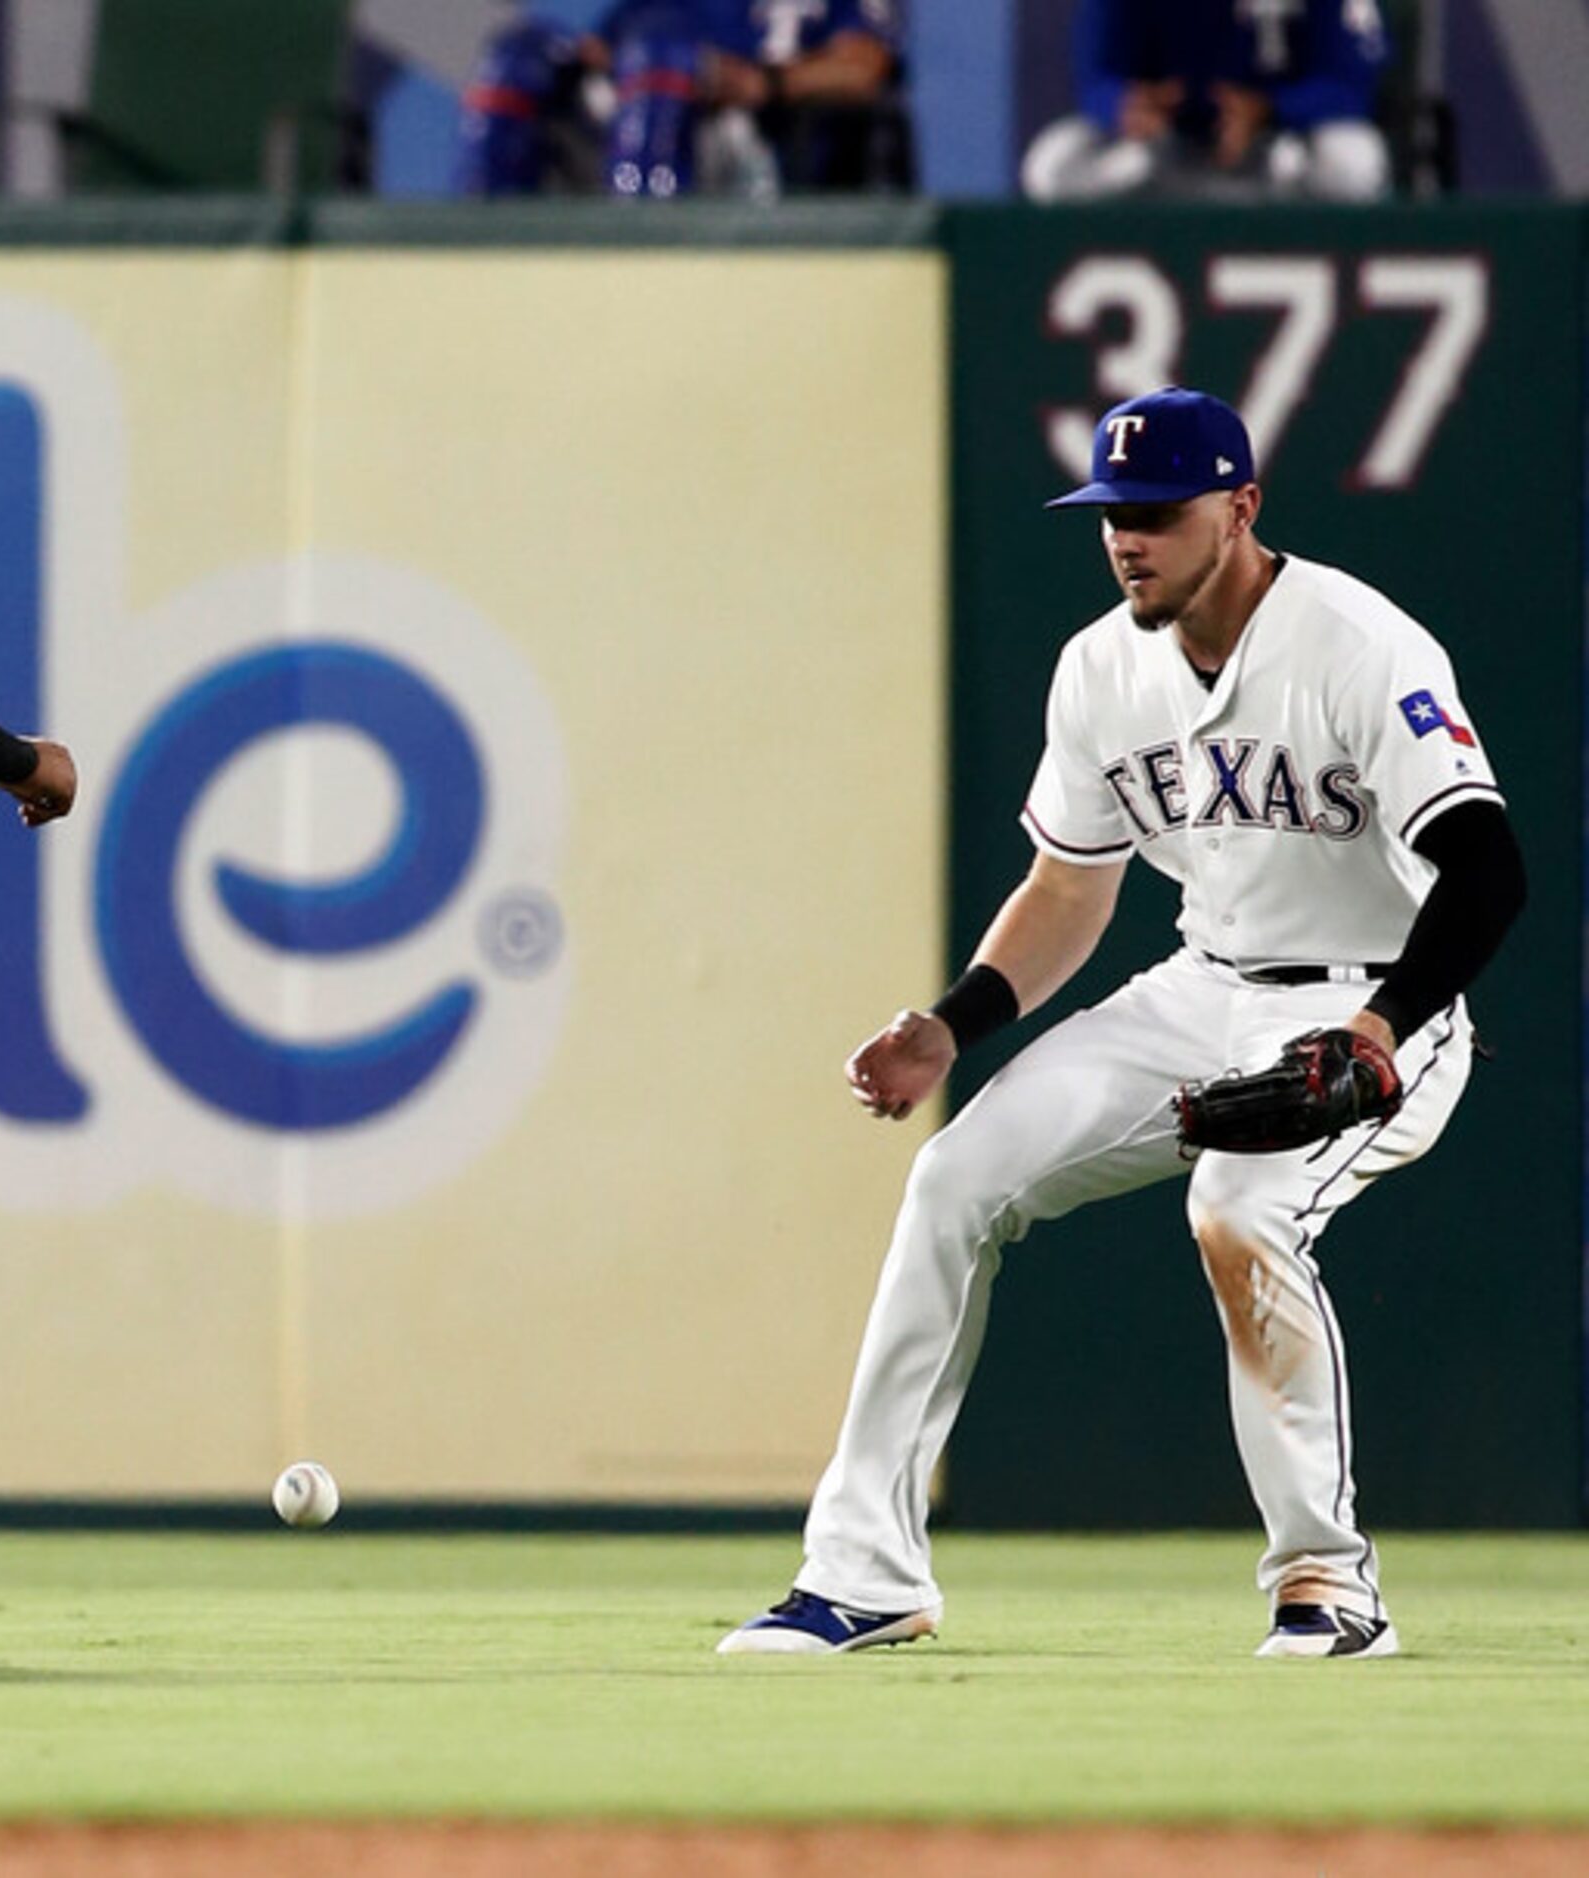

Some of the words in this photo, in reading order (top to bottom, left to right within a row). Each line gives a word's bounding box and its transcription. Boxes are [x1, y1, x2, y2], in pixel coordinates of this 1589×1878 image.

[1046, 250, 1492, 492] 377
[1106, 414, 1148, 465] T
[1100, 738, 1368, 842] TEXAS
